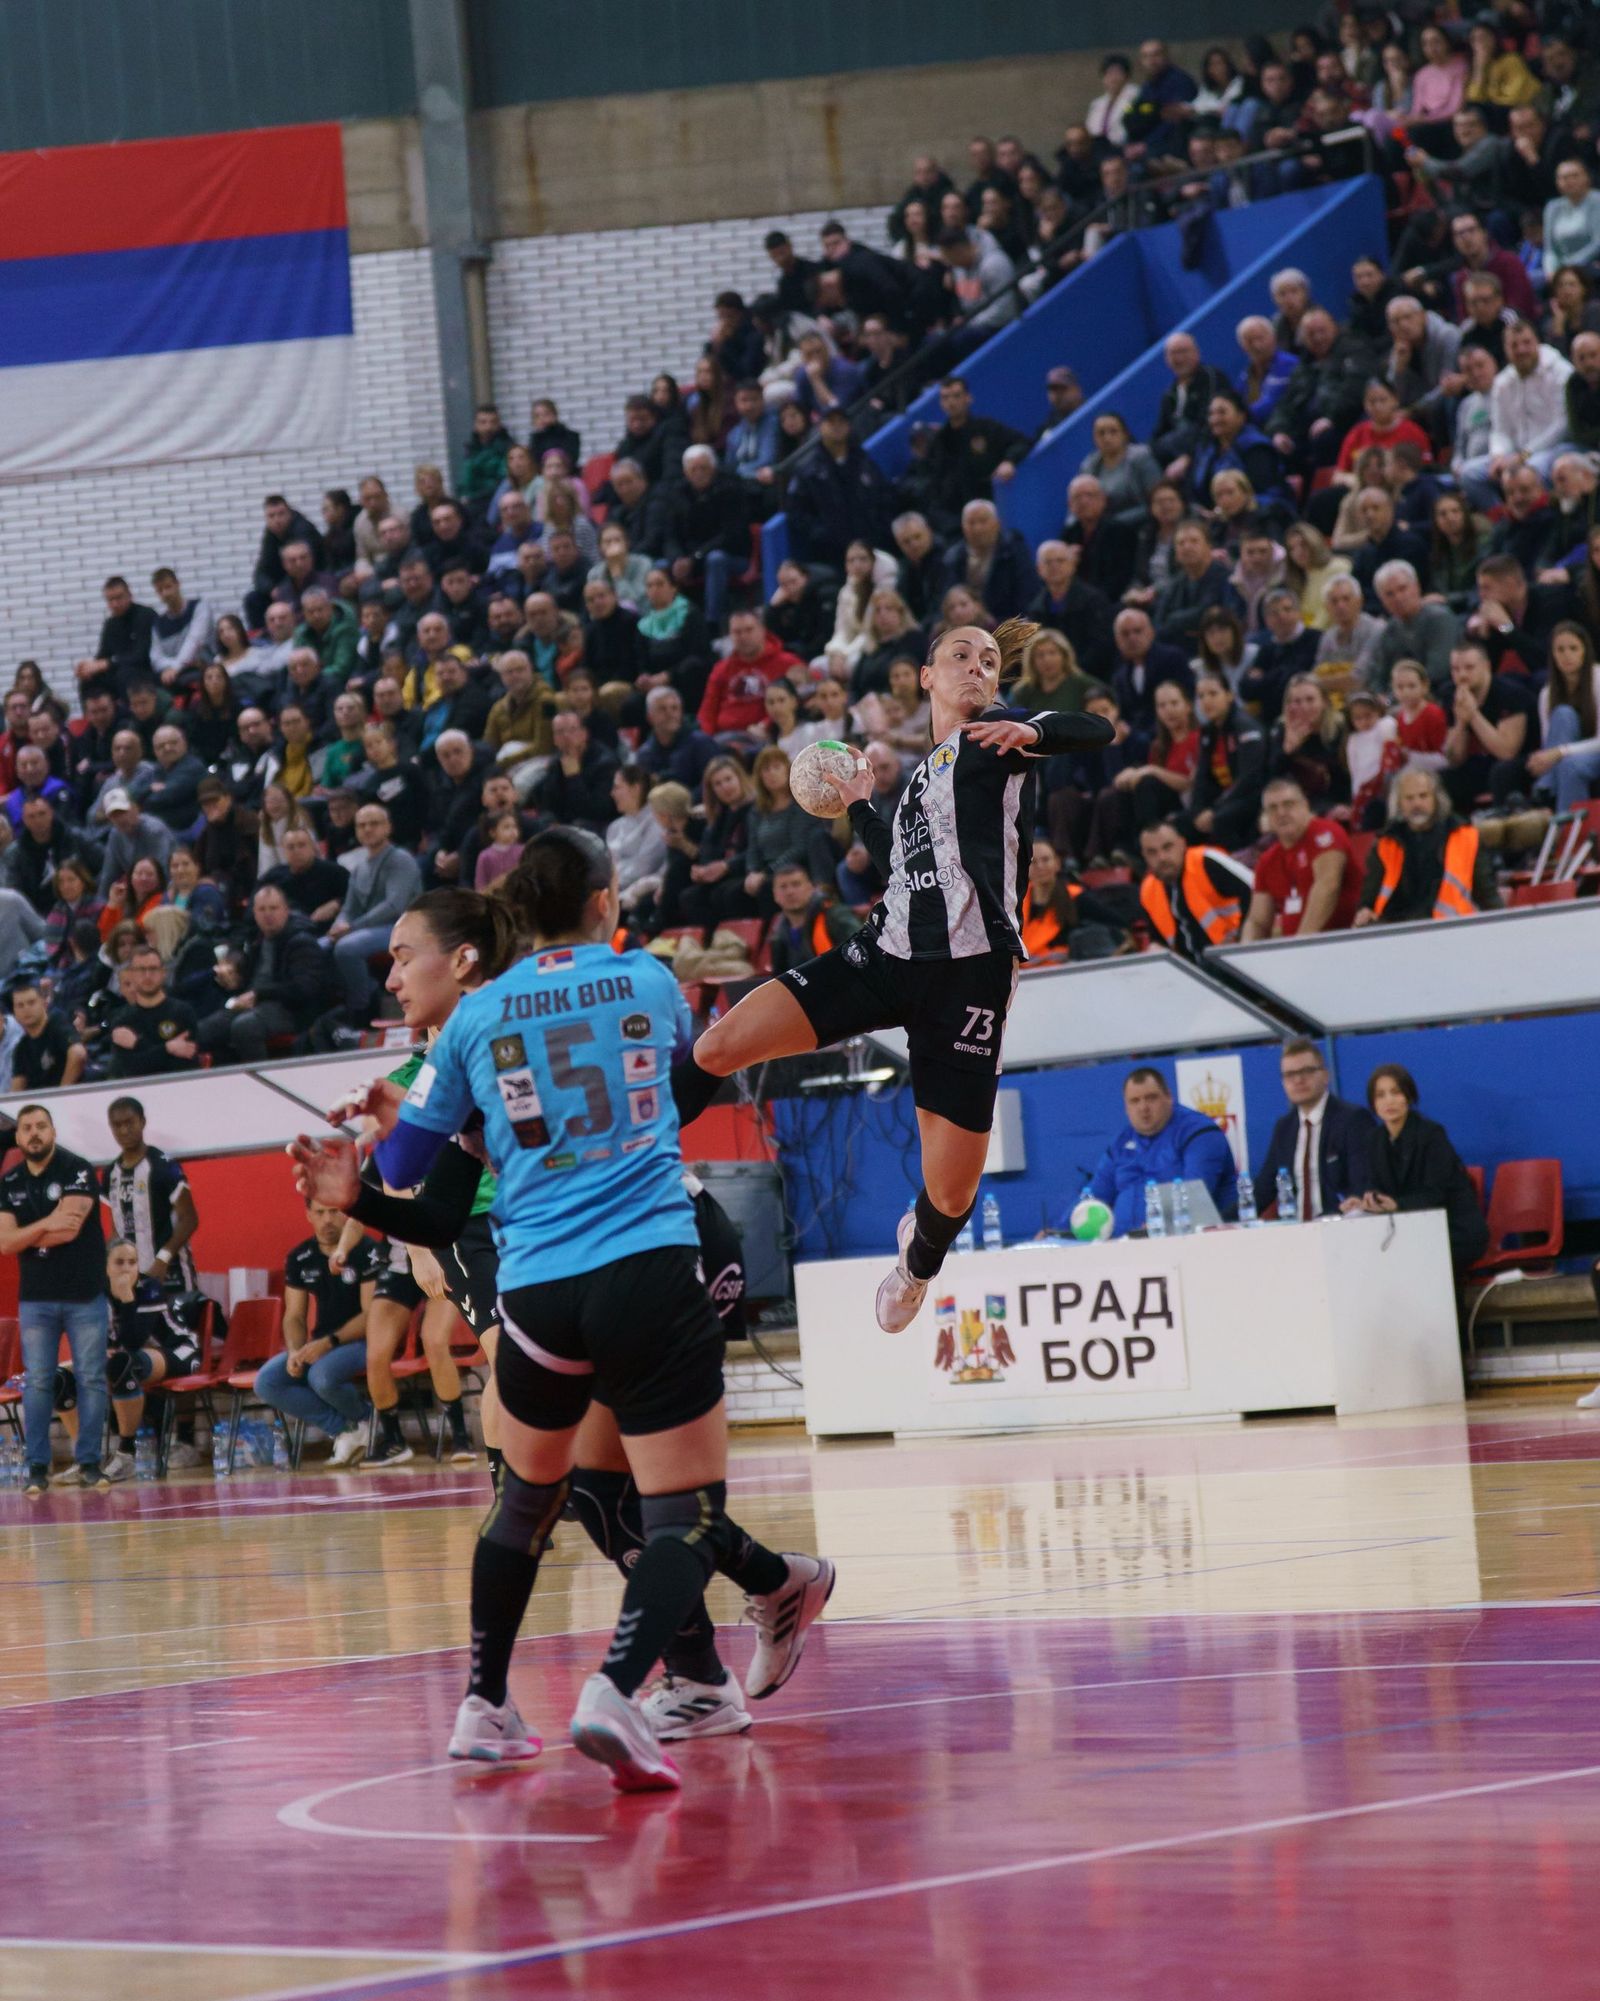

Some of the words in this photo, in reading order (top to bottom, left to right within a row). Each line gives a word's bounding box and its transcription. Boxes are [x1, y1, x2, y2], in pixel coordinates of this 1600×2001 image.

[577, 976, 635, 1008] BOR
[960, 1005, 995, 1041] 73
[544, 1022, 613, 1137] 5
[1019, 1276, 1174, 1331] ГРАД
[1041, 1336, 1156, 1383] БОР
